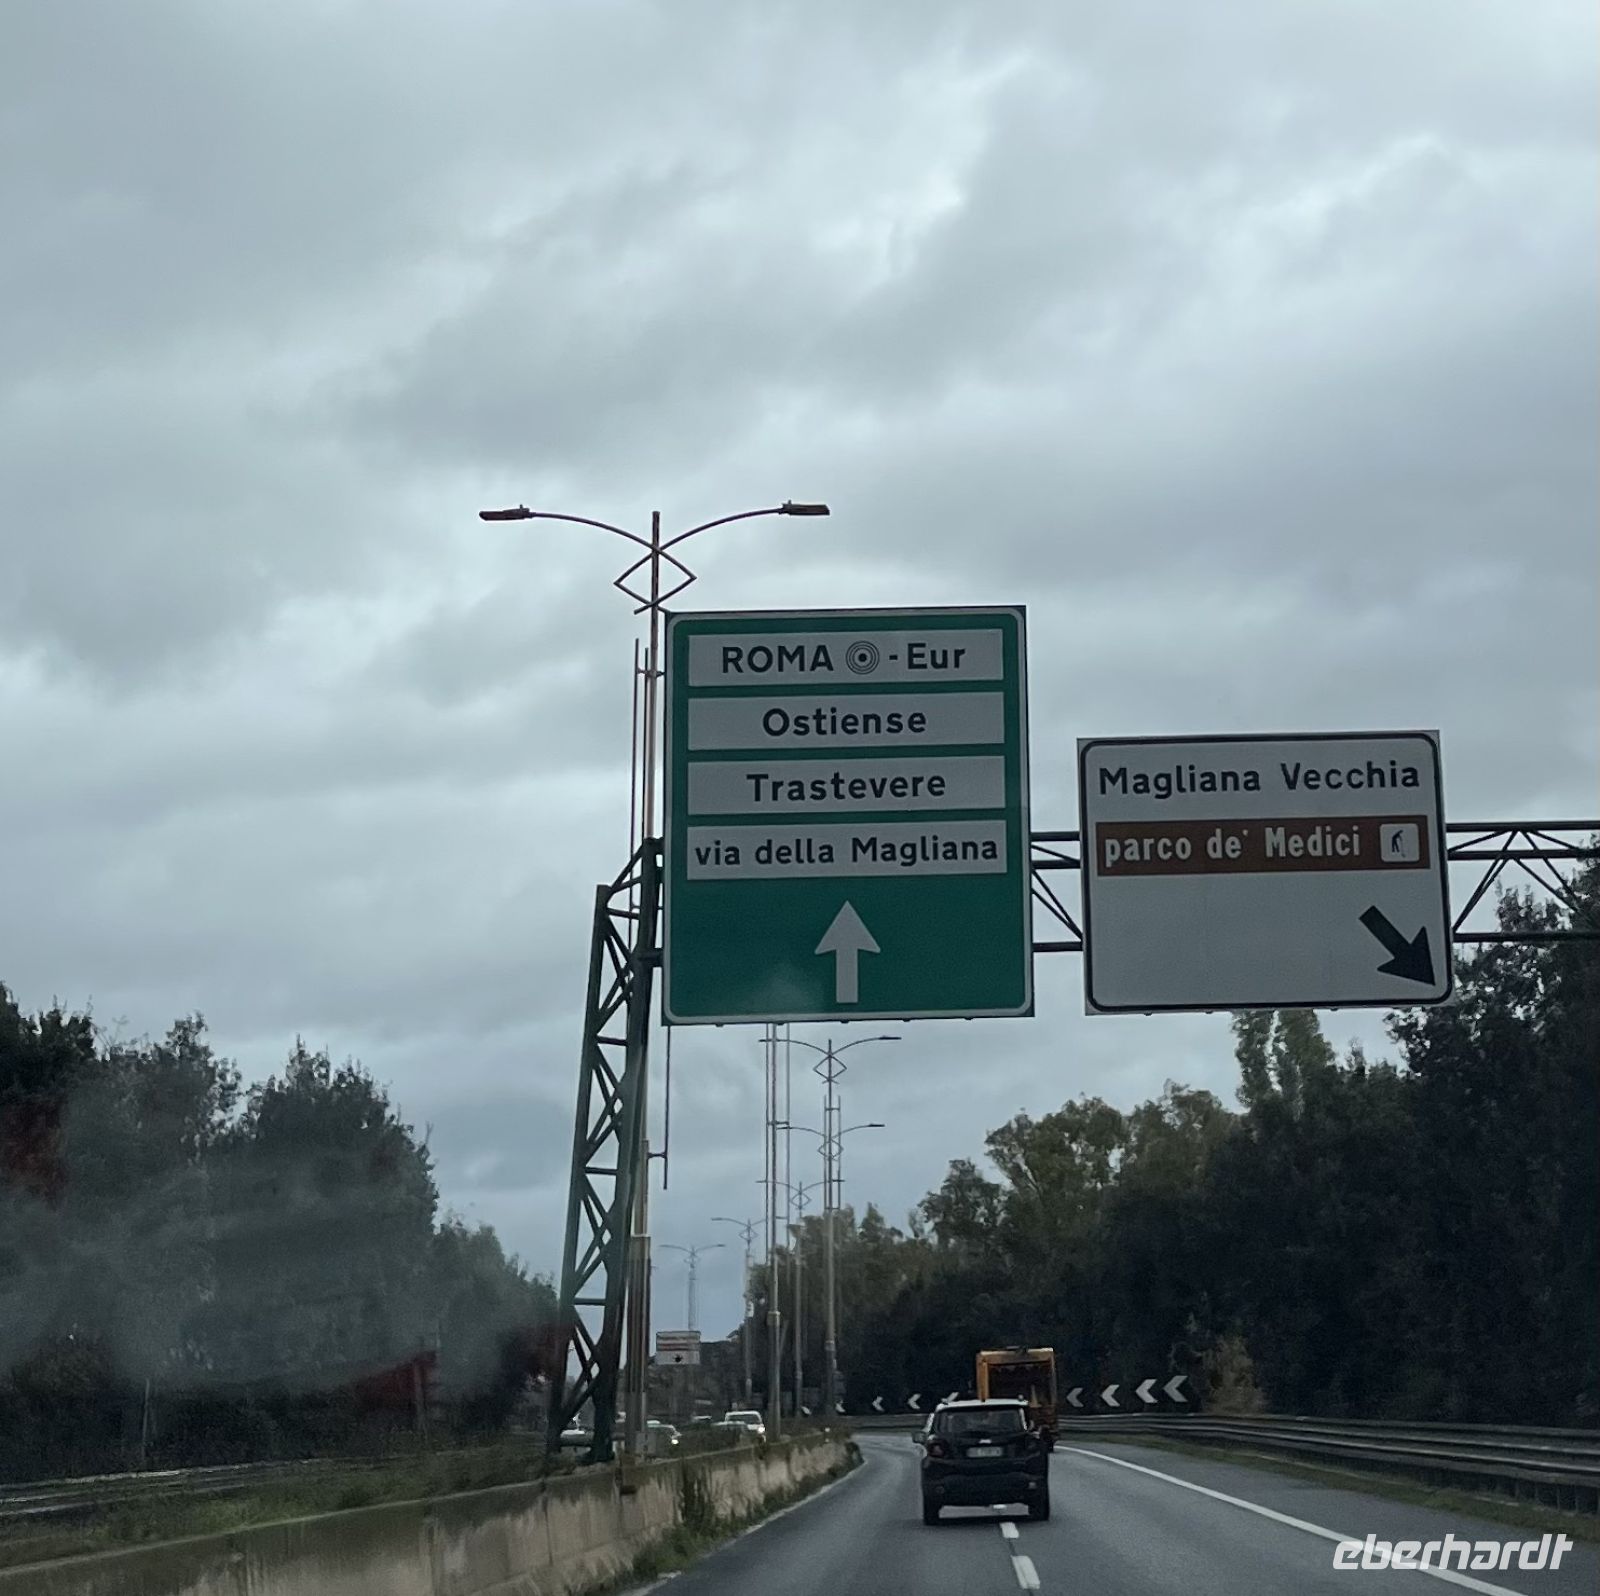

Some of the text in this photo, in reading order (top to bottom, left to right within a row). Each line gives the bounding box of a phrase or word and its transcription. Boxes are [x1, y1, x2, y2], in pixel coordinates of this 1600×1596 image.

[722, 645, 834, 673] ROMA
[762, 707, 927, 737] Ostiense
[746, 772, 946, 802] Trastevere
[1099, 760, 1420, 799] Magliana Vecchia
[695, 835, 998, 867] via della Magliana
[1105, 825, 1361, 868] parco de' Medici
